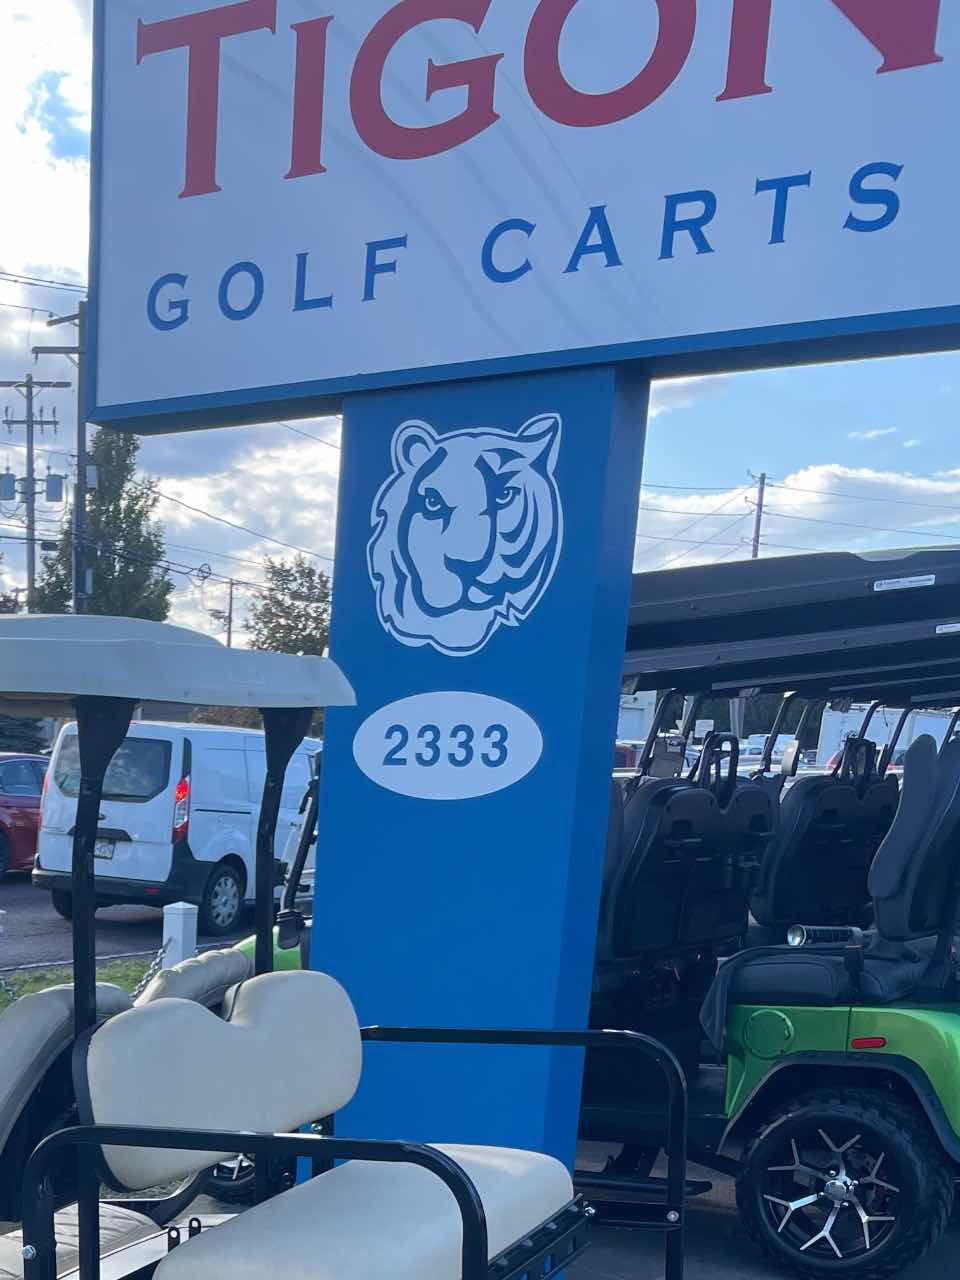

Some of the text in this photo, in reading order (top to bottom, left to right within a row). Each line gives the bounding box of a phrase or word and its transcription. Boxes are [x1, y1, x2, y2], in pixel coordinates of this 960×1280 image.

[136, 0, 944, 199] TIGON
[146, 161, 904, 332] GOLF CARTS
[382, 723, 508, 768] 2333
